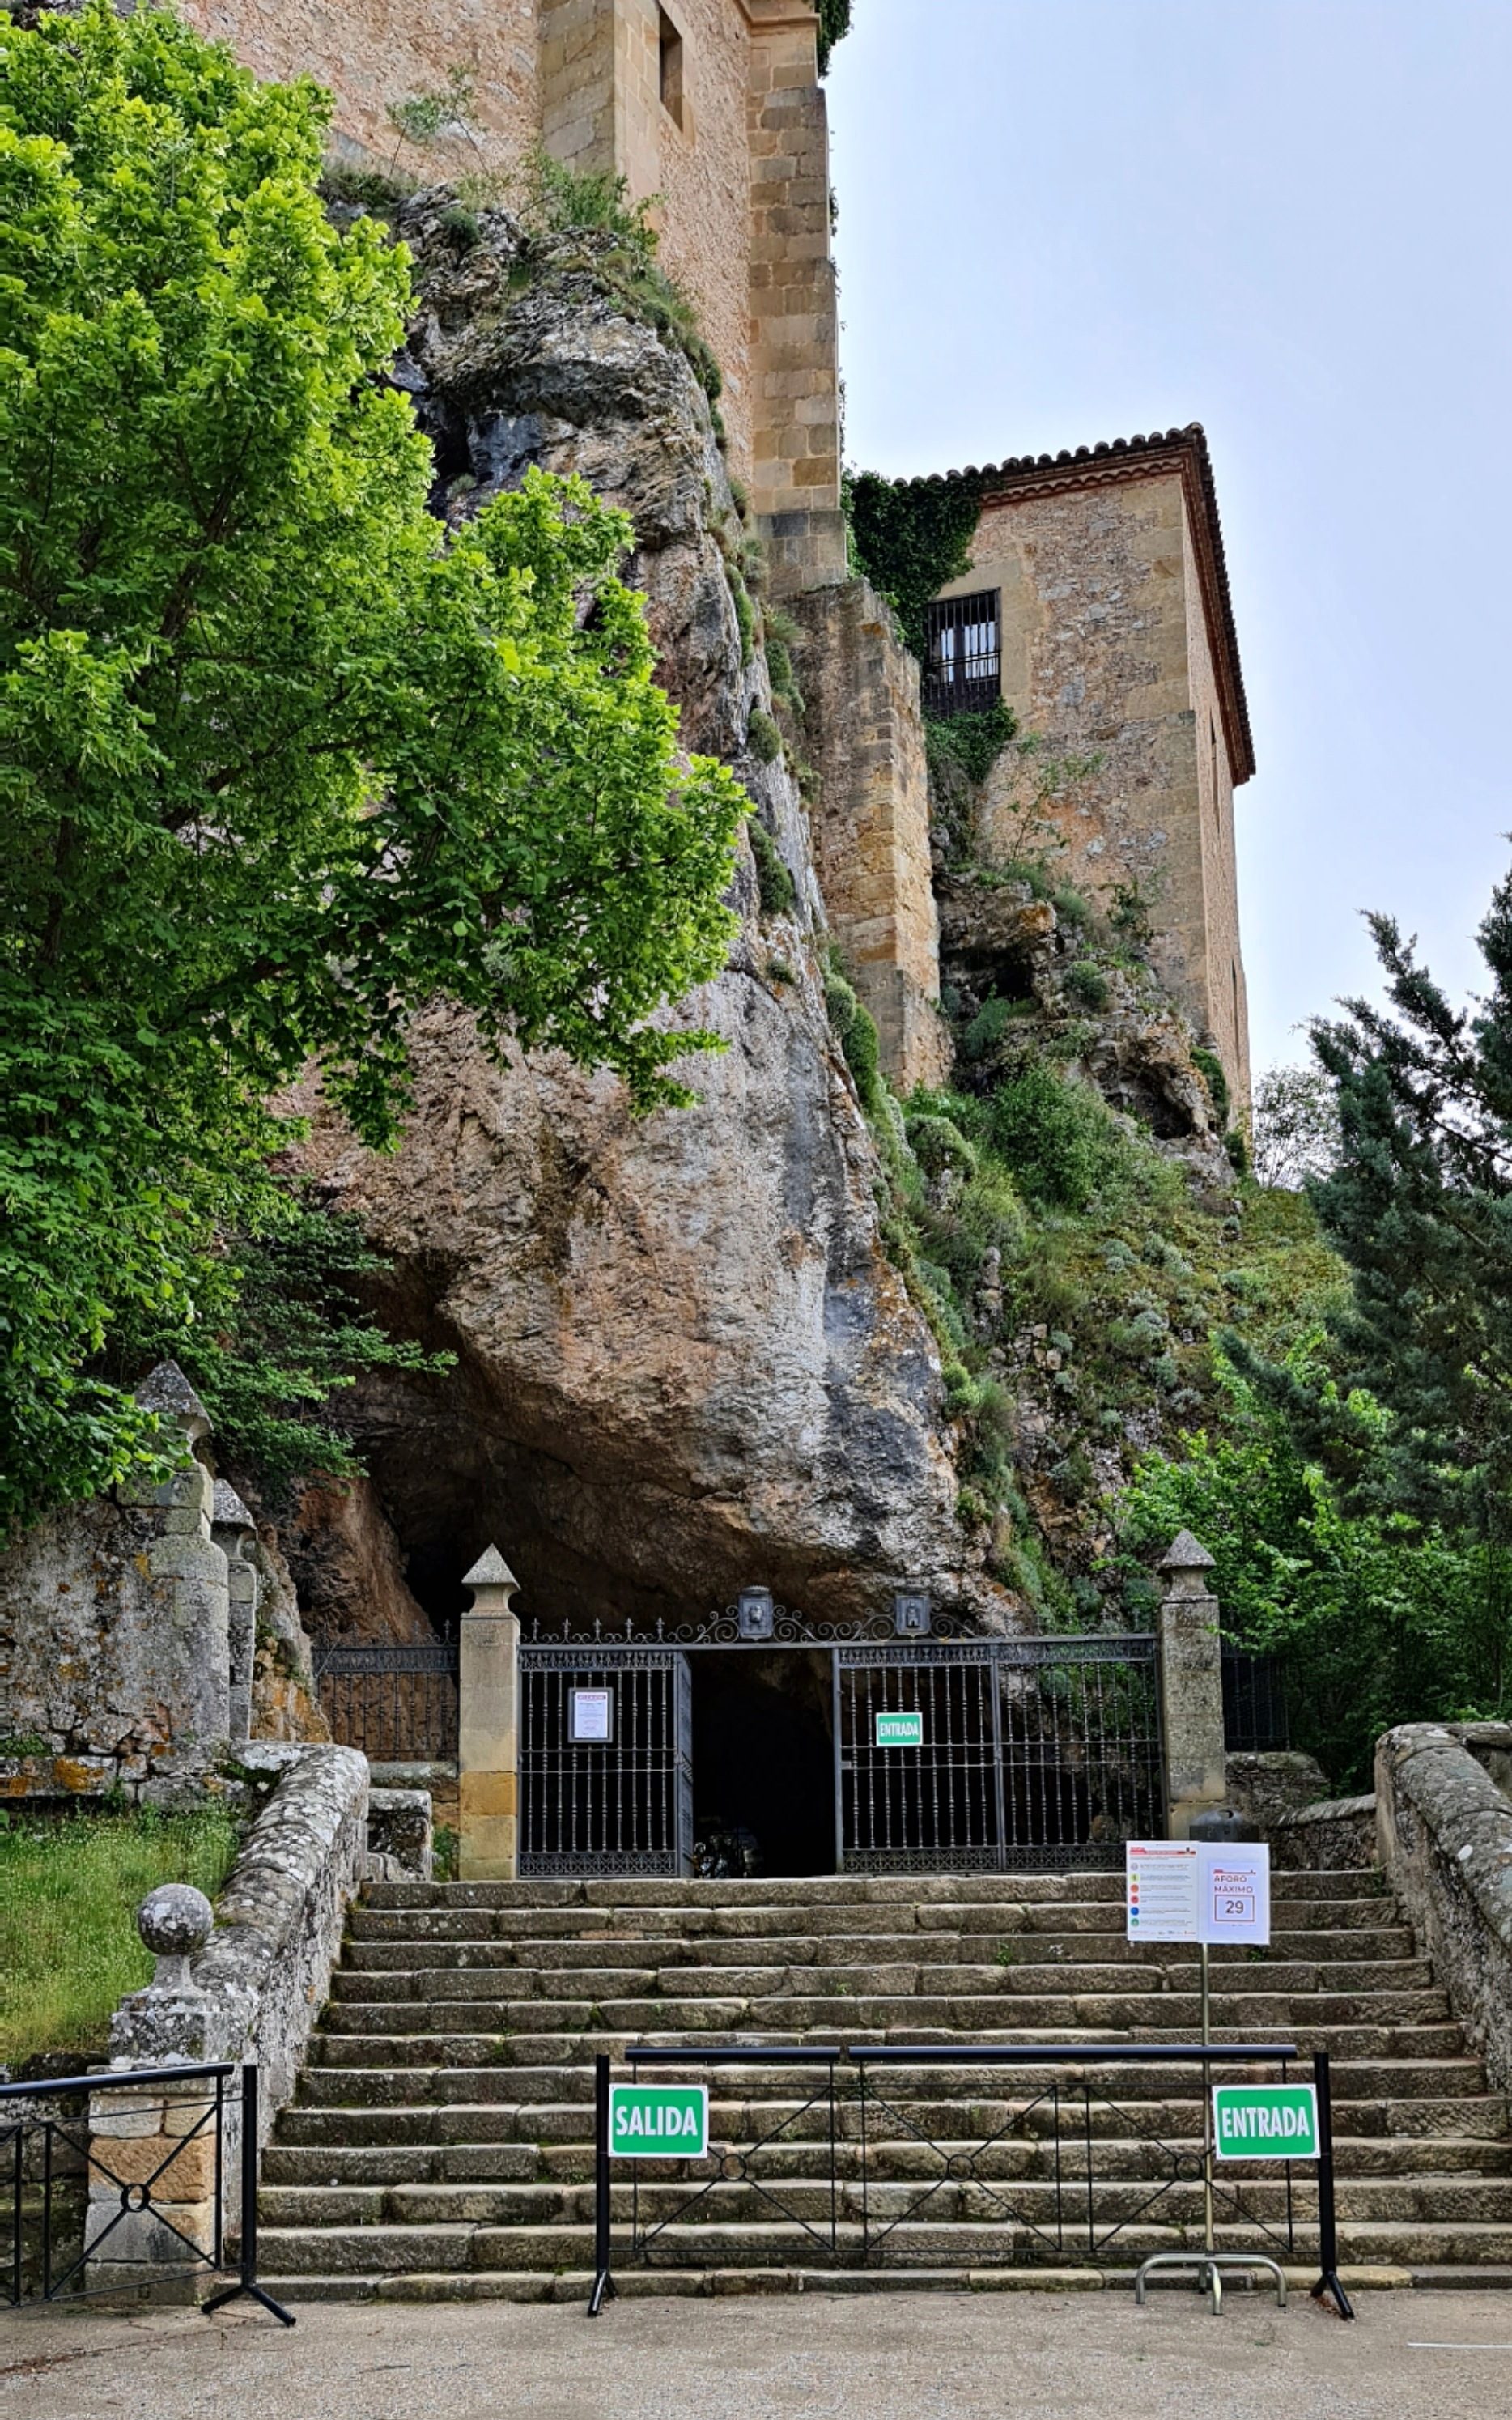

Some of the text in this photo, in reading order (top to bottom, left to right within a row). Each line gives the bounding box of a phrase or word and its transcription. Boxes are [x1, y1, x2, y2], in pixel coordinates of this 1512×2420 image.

[880, 1721, 919, 1737] ENTRADA
[1214, 1884, 1253, 1893] MÁXIMO
[1225, 1900, 1244, 1914] 29
[616, 2106, 698, 2136] SALIDA
[1221, 2106, 1310, 2137] ENTRADA
